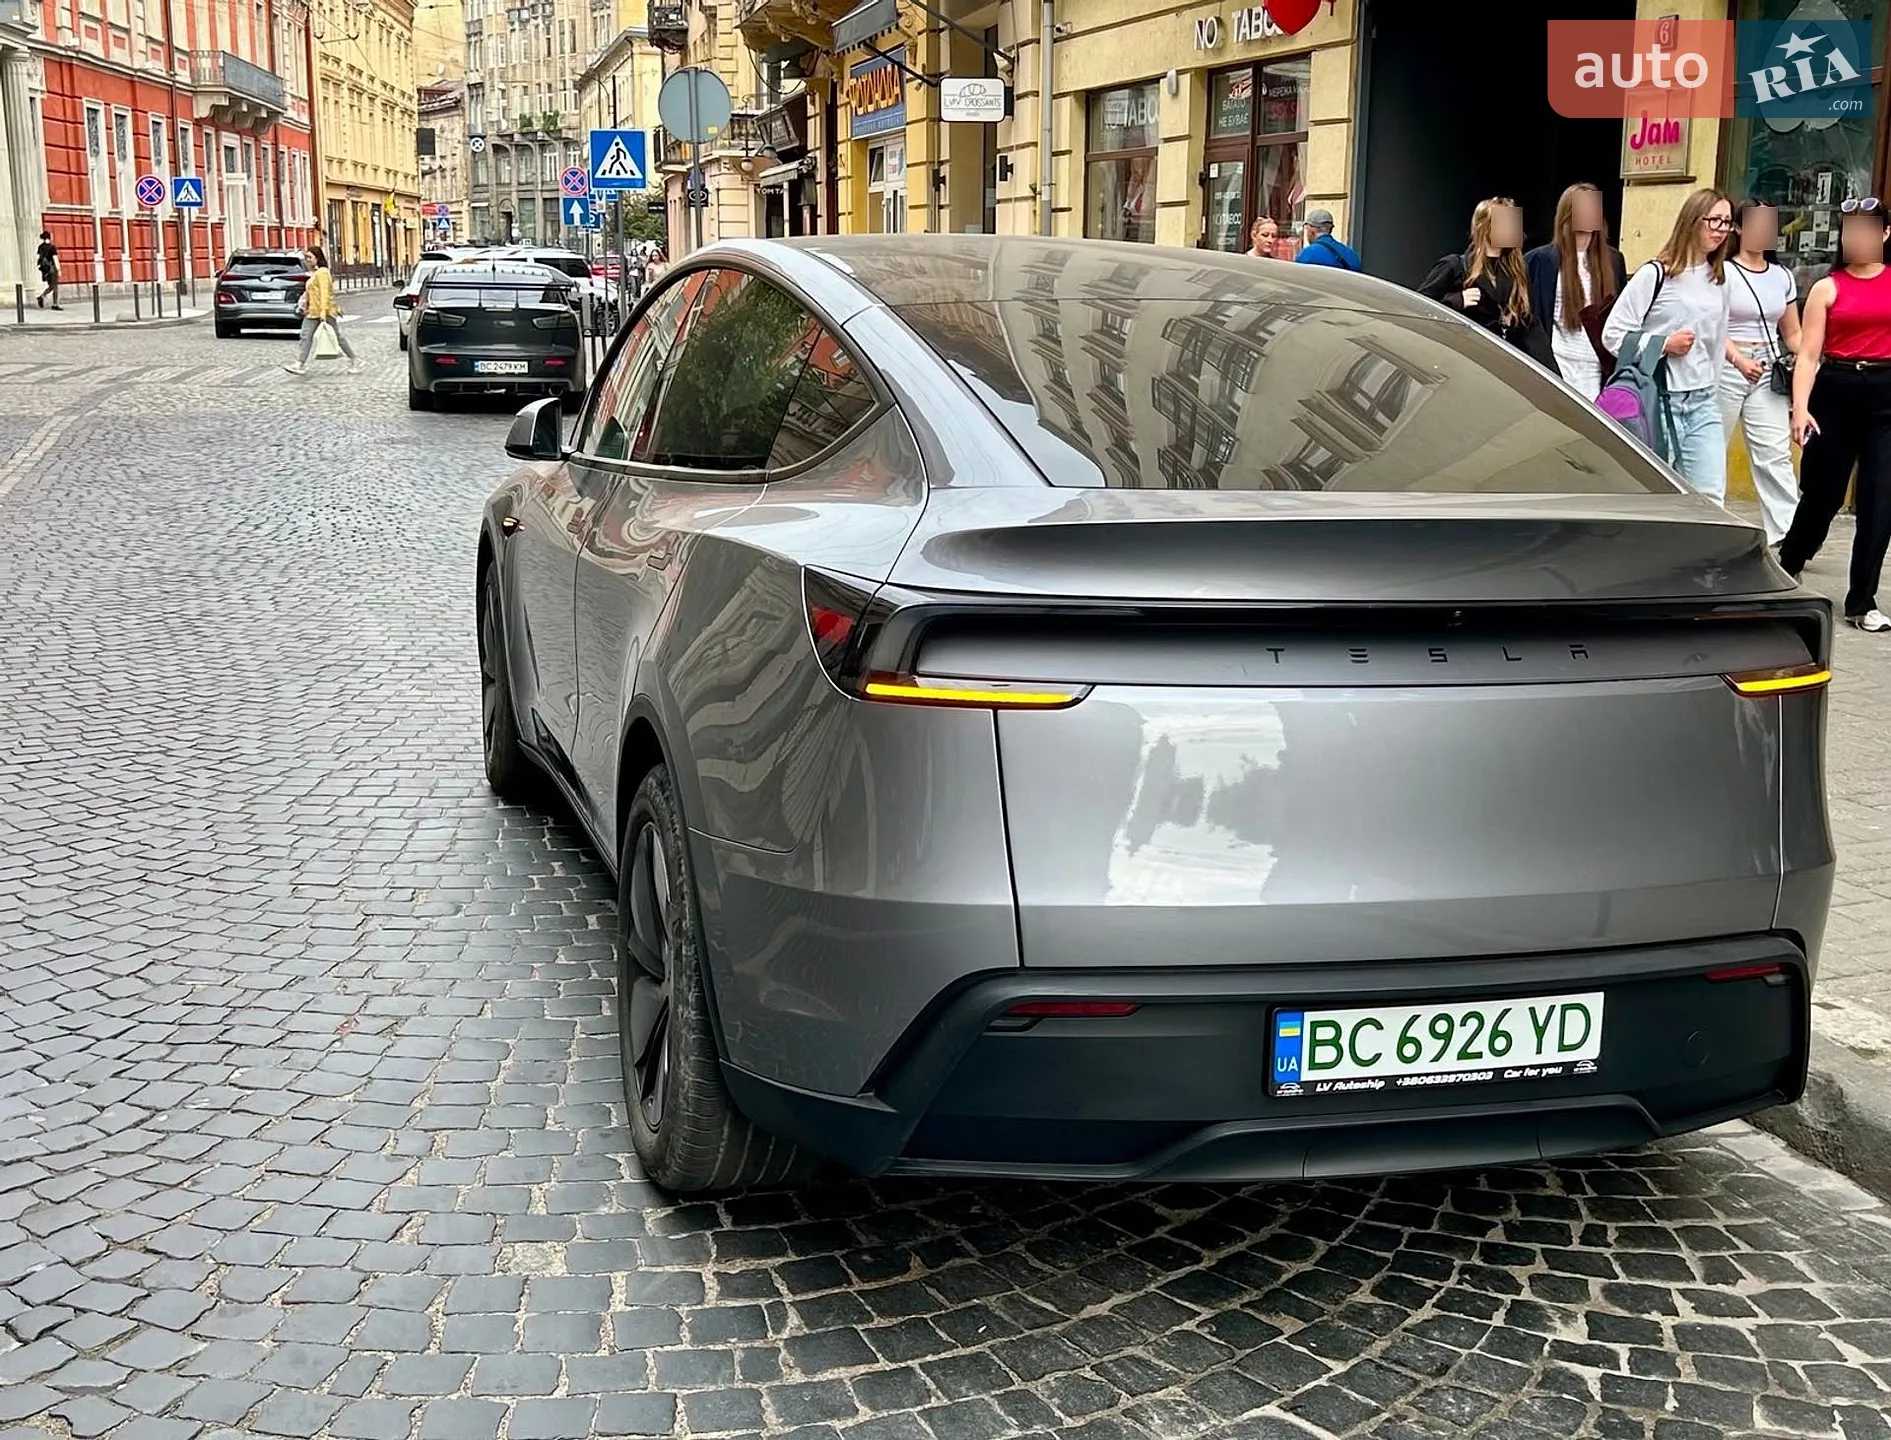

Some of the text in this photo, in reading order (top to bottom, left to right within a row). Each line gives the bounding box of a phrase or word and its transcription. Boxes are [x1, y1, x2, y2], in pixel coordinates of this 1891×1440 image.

[1194, 6, 1284, 50] NO TABO
[1659, 20, 1669, 44] 6
[1635, 155, 1672, 166] HOTEL
[1266, 644, 1589, 664] TESLA
[1308, 1003, 1592, 1071] BC 6926 YD
[1277, 1056, 1299, 1073] UA
[1316, 1082, 1334, 1092] LV
[1333, 1079, 1386, 1092] Autoship
[1504, 1069, 1522, 1079] Car
[1523, 1067, 1541, 1078] for
[1541, 1066, 1563, 1078] you
